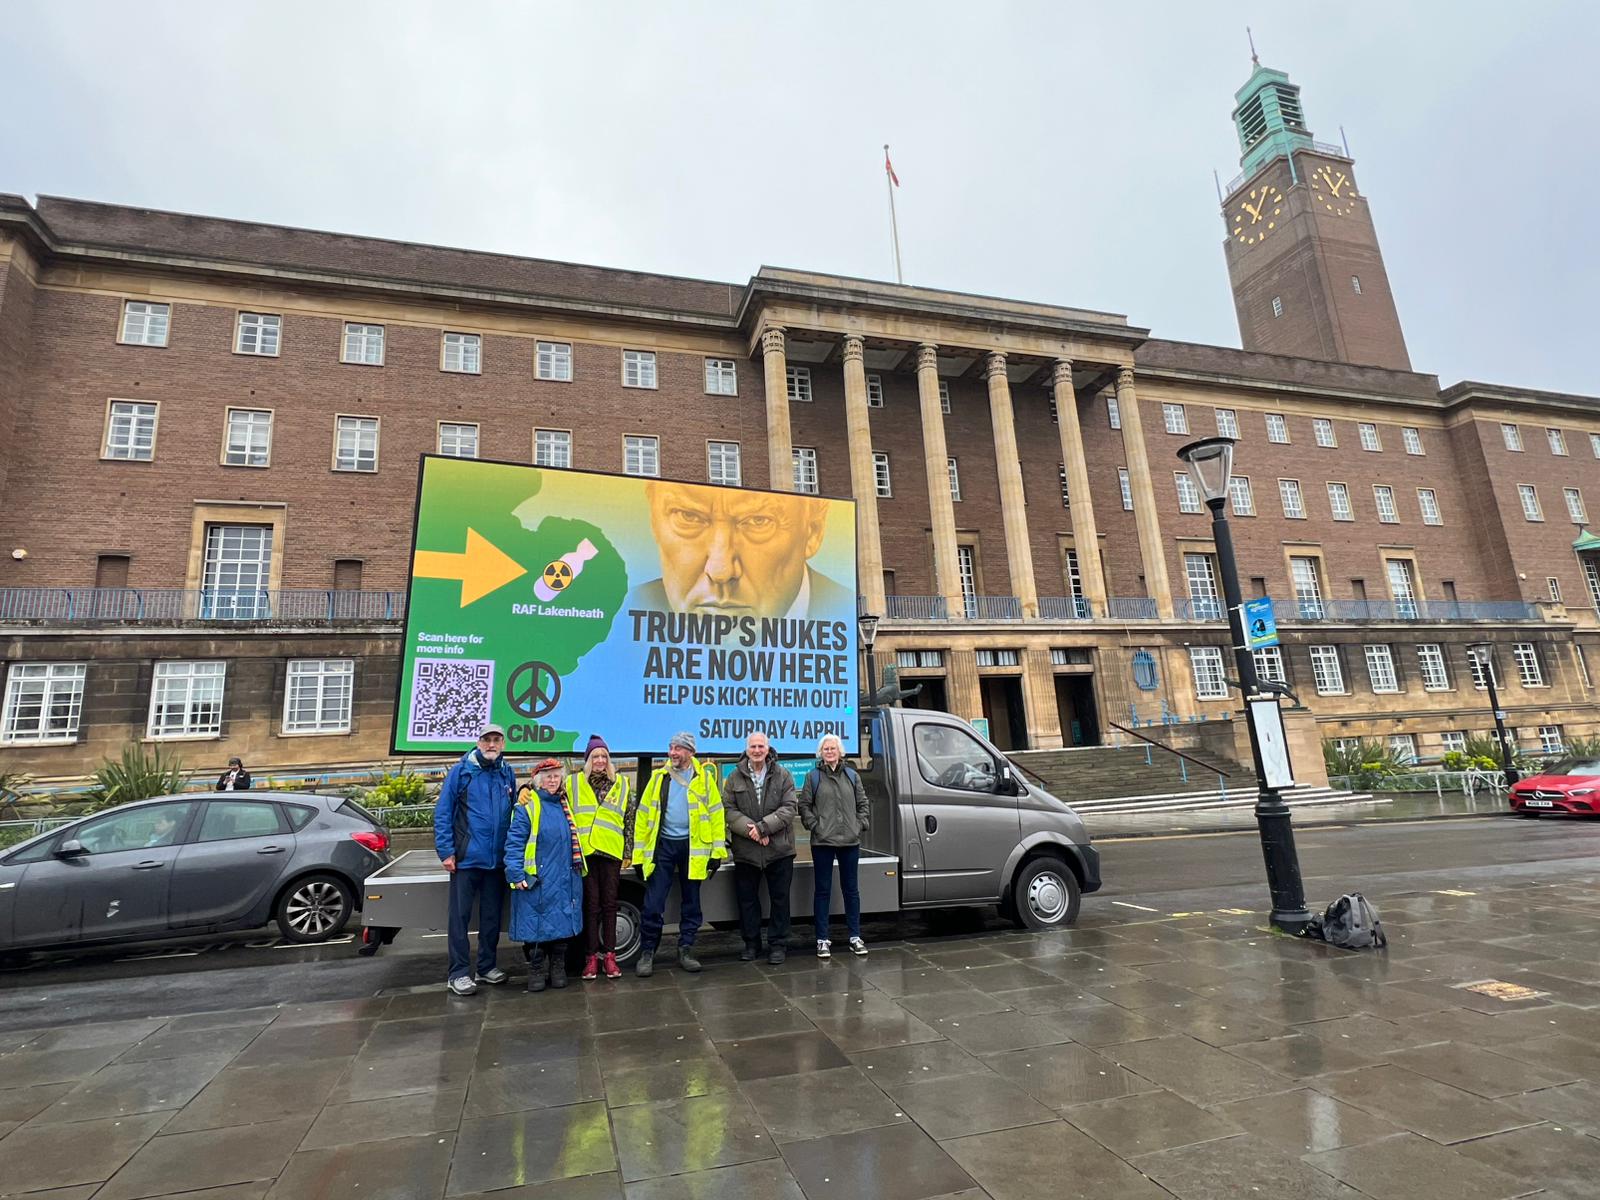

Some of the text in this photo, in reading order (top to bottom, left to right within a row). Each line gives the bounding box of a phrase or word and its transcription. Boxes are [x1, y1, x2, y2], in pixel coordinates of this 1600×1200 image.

[512, 603, 604, 619] RAF Lakenheath
[418, 632, 484, 644] Scan here for
[761, 617, 848, 651] NUKES
[416, 644, 464, 655] more info
[643, 647, 848, 684] ARE NOW HERE
[644, 684, 848, 708] HELP US KICK THEM OUT!
[507, 724, 555, 742] CND
[699, 719, 849, 740] SATURDAY 4 APRIL
